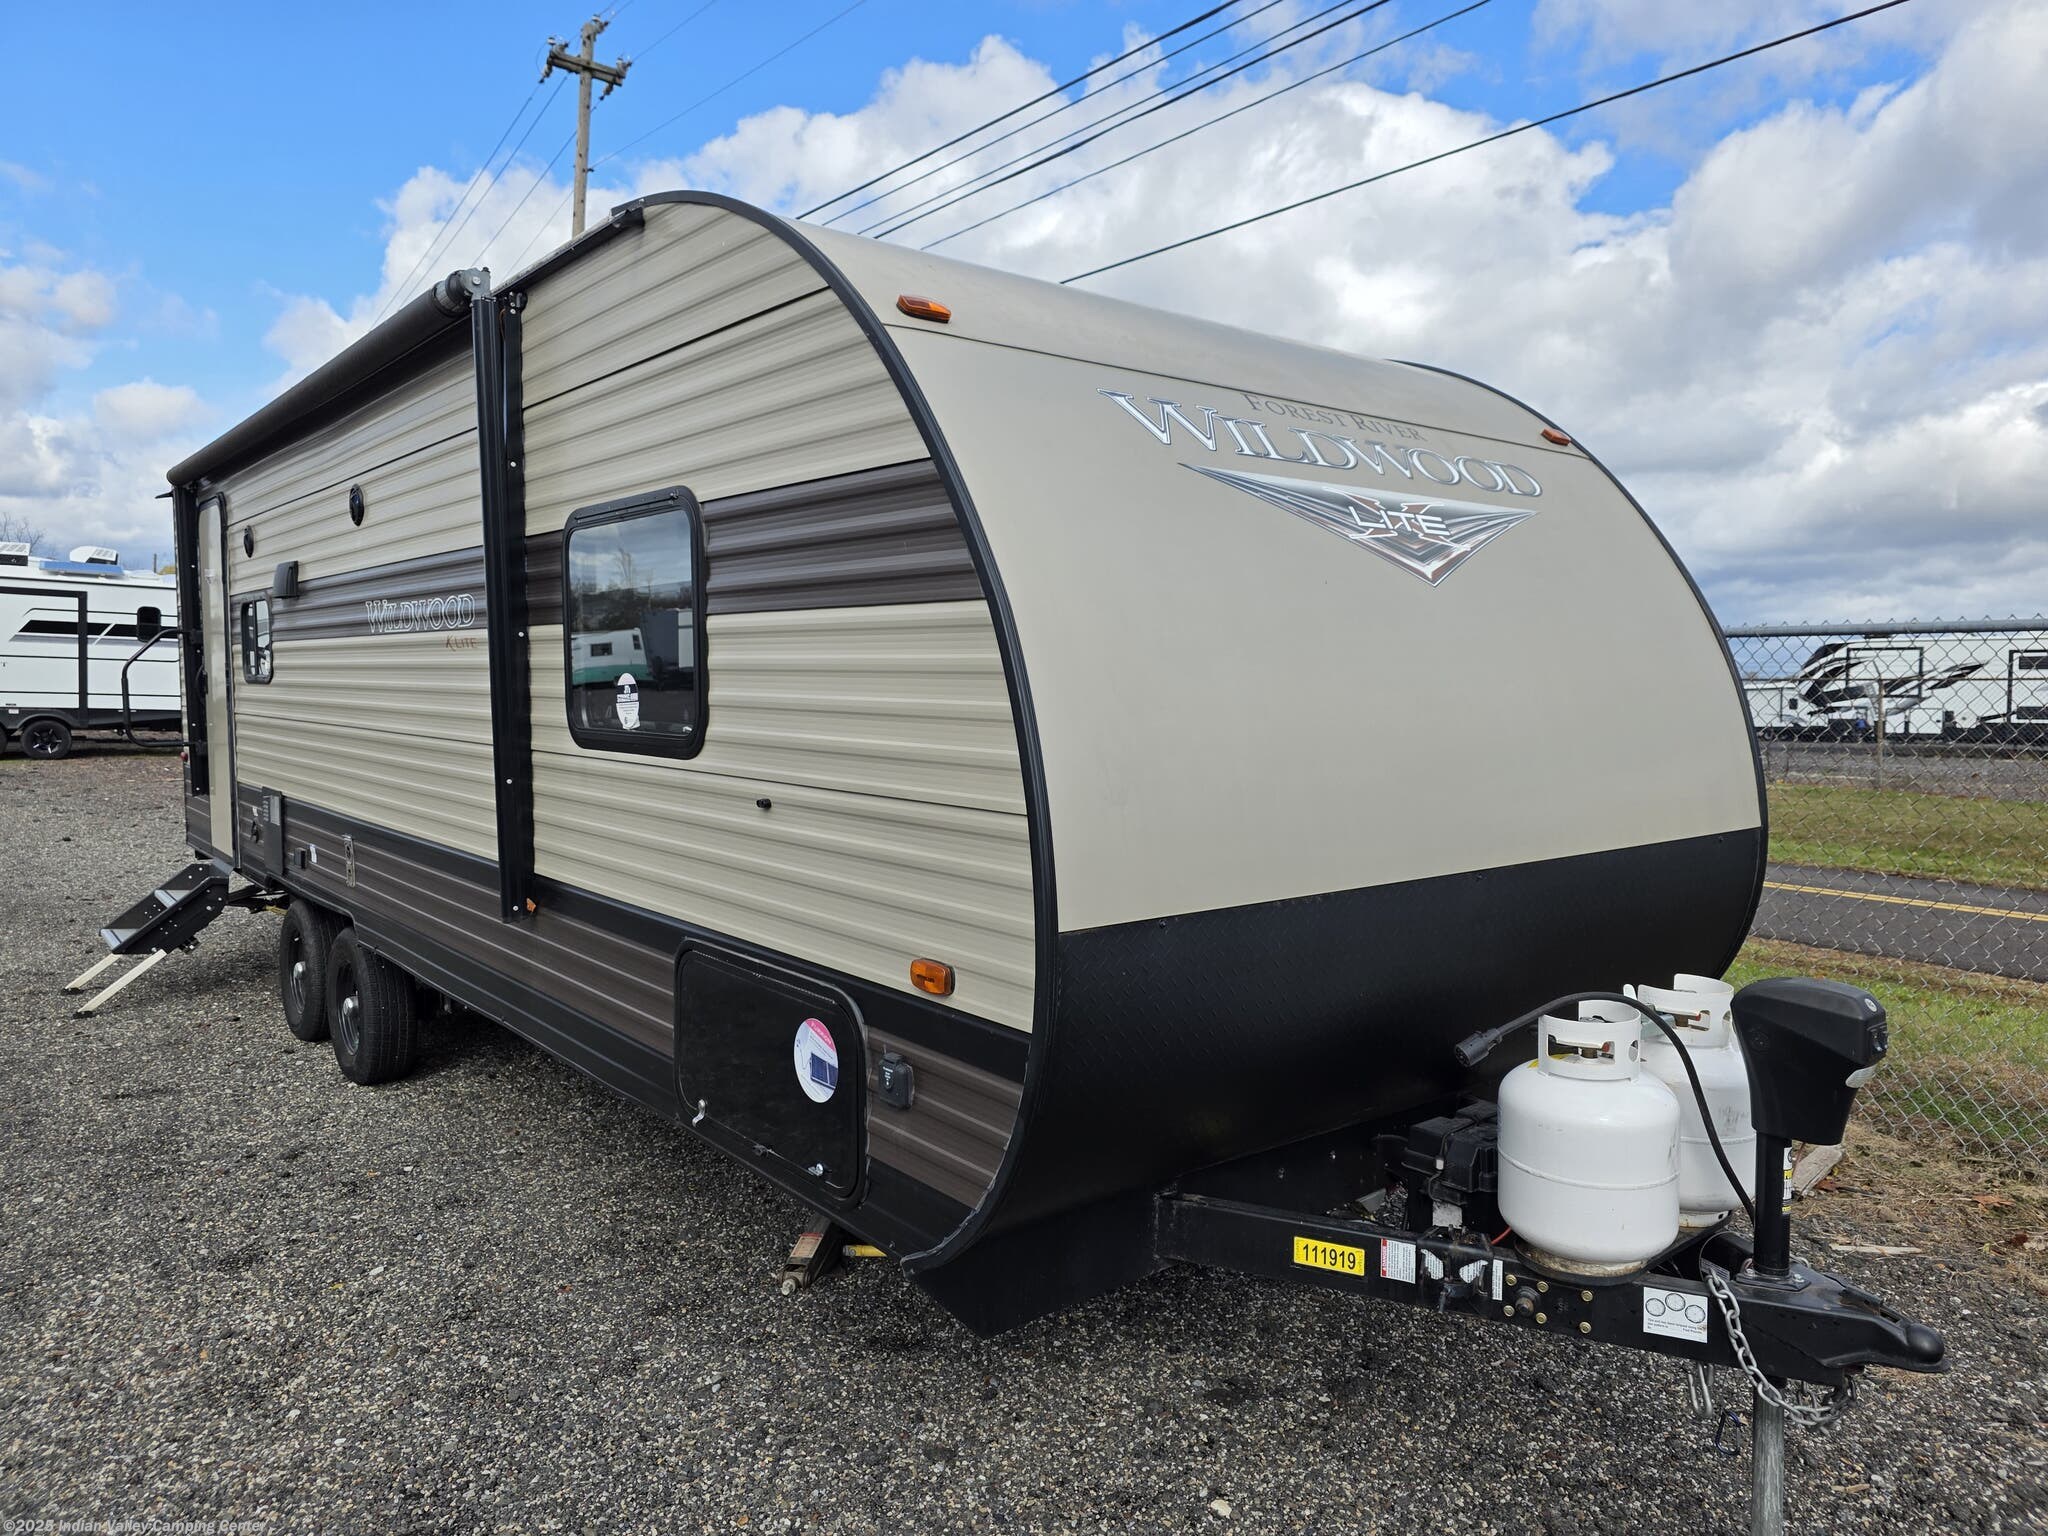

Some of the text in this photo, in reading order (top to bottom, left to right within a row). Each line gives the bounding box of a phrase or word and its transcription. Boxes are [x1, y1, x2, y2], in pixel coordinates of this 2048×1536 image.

[1241, 393, 1428, 442] FOREST RIVER
[1096, 387, 1543, 497] WILDWOOD
[366, 594, 475, 632] WILDWOOD
[1302, 1243, 1357, 1270] 111919
